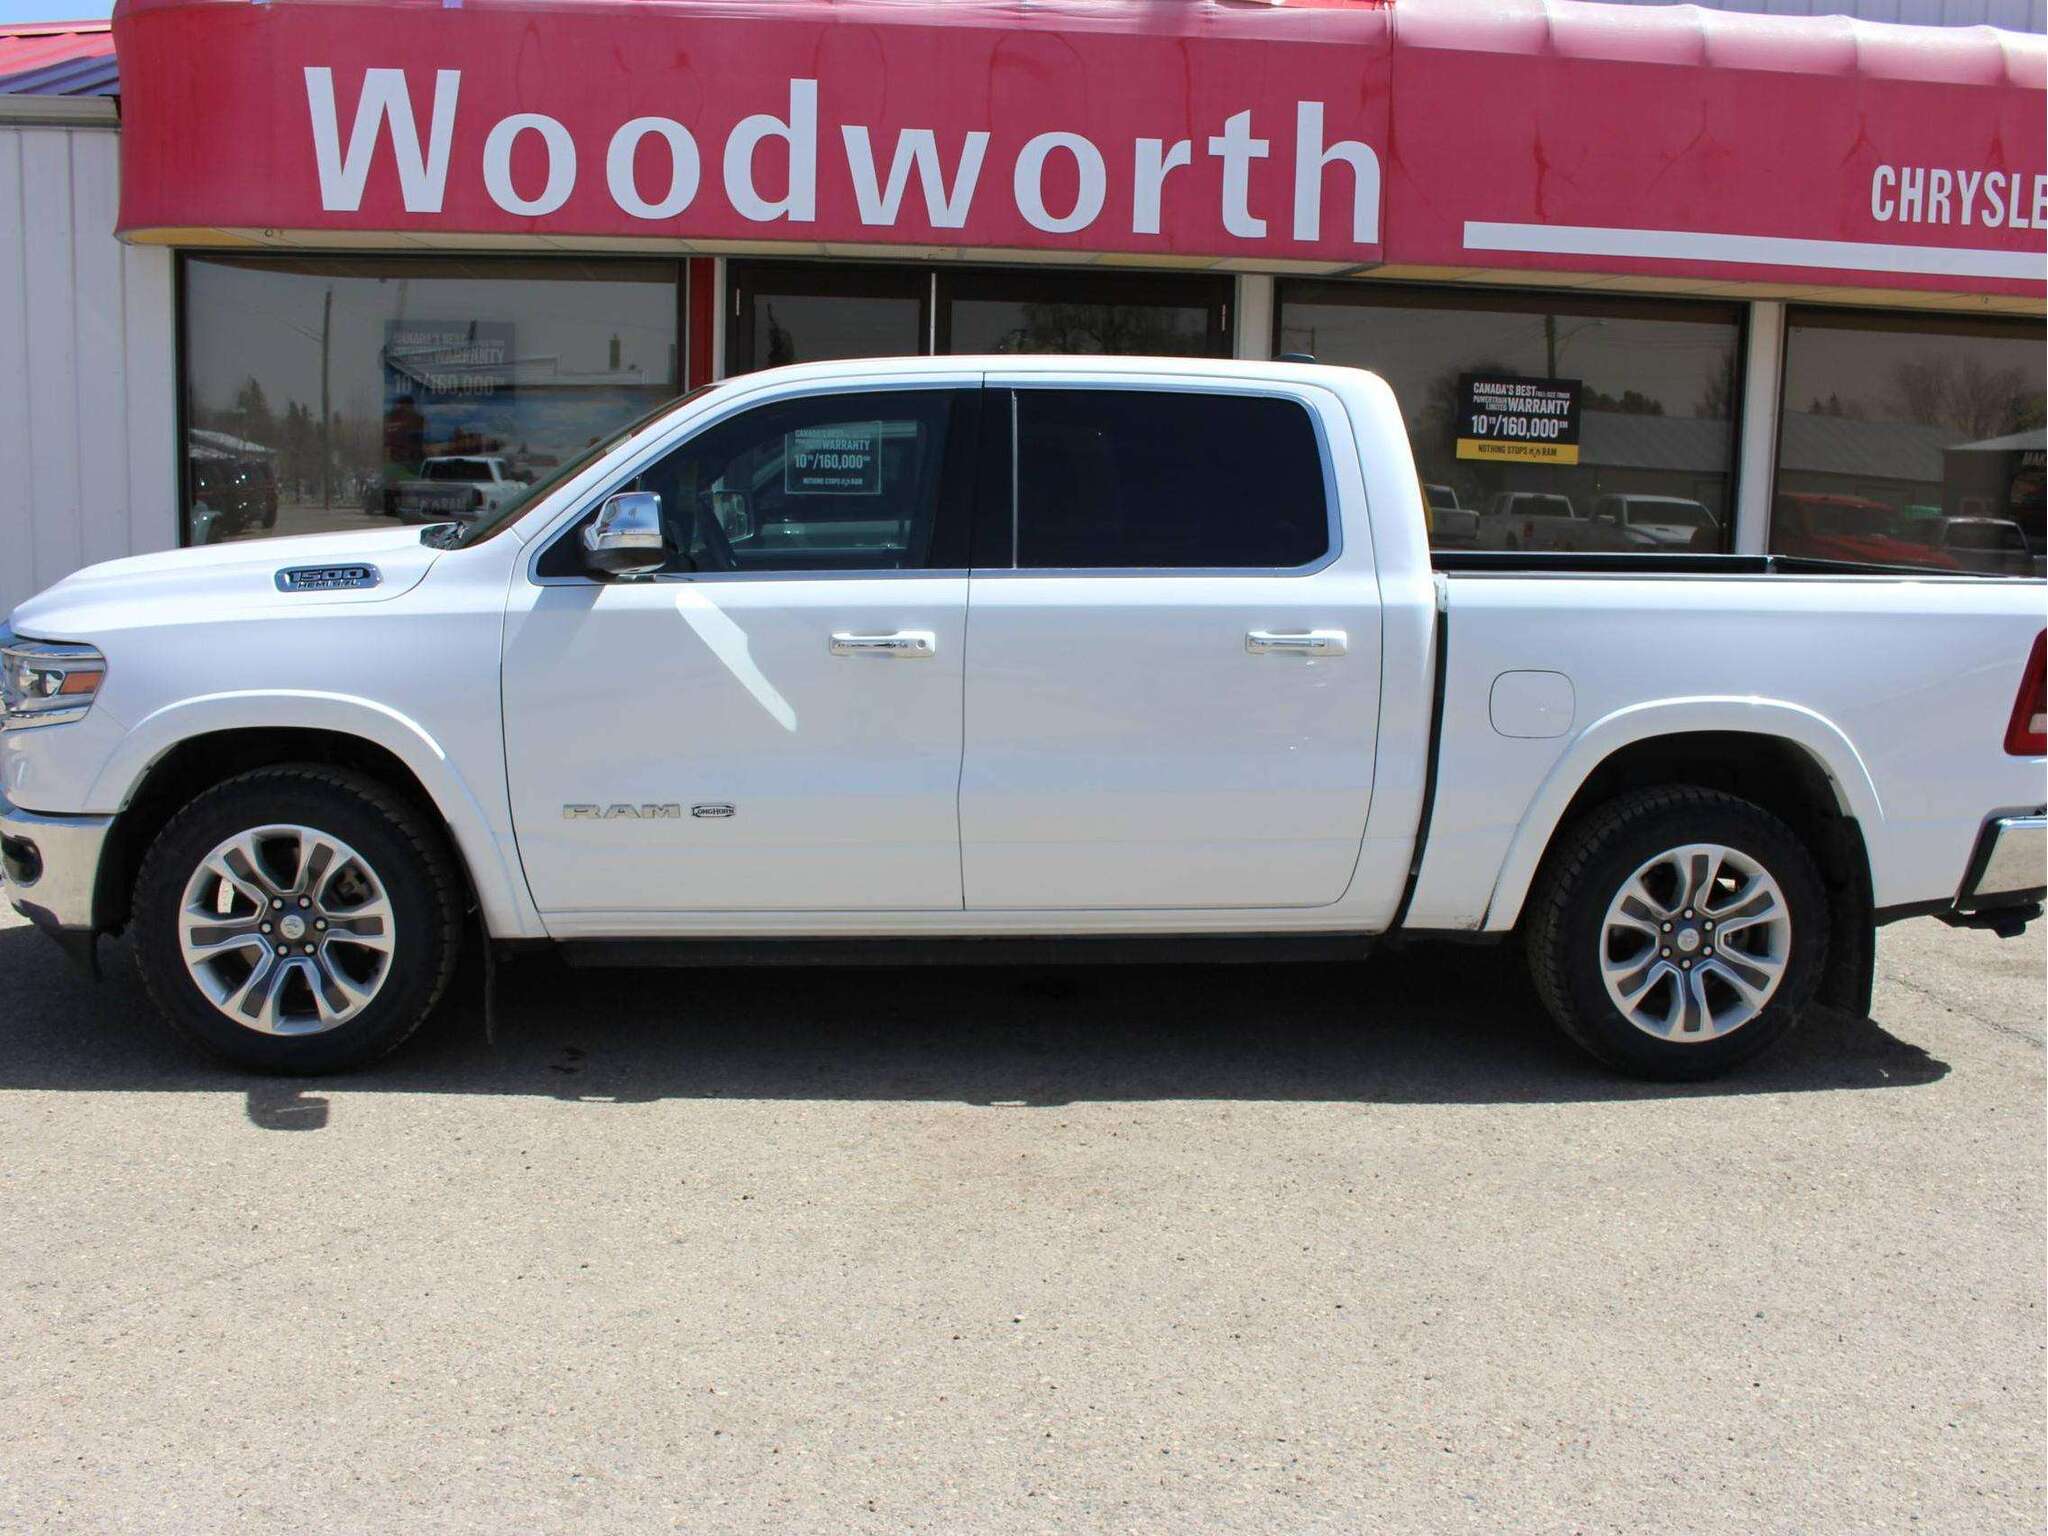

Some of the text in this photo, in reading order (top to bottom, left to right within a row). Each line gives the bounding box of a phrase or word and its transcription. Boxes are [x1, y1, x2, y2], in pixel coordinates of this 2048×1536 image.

[304, 66, 1380, 244] Woodworth
[1473, 382, 1514, 395] CANADA'S
[1515, 385, 1537, 396] BEST
[1507, 398, 1570, 415] WARRANTY
[822, 439, 870, 450] WARRANTY
[289, 568, 364, 583] 1500
[563, 804, 681, 819] RAM
